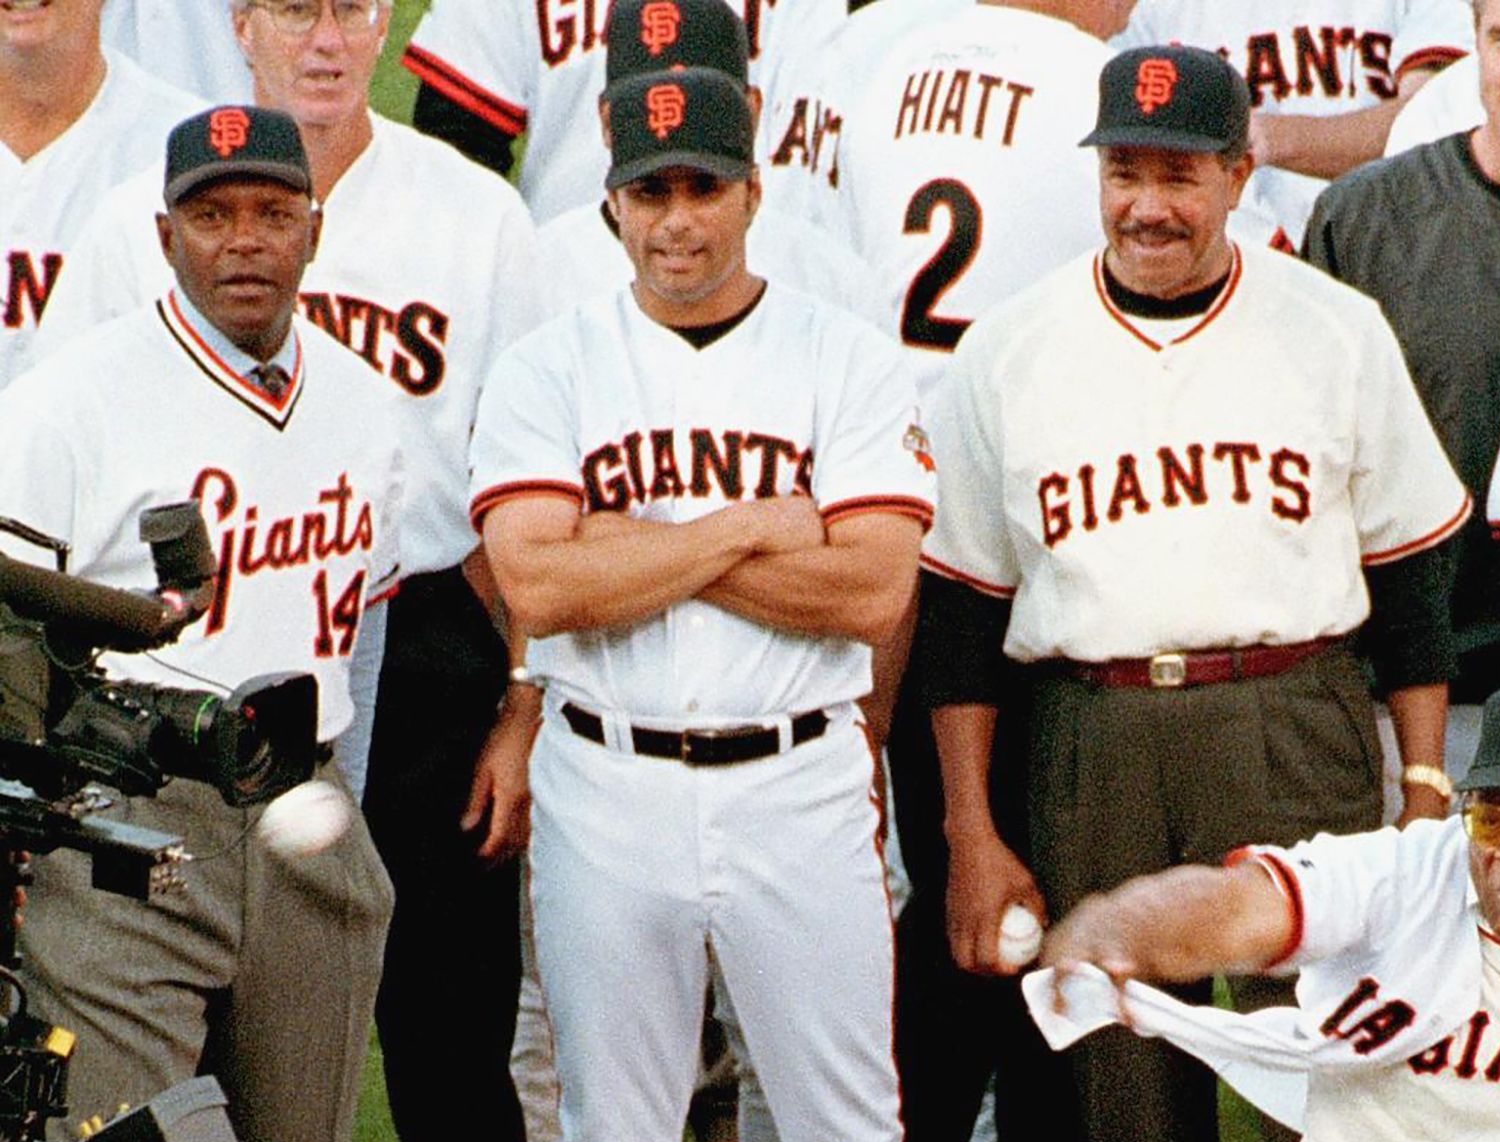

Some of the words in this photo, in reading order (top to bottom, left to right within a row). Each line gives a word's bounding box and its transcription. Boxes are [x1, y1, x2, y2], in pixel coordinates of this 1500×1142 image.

[894, 68, 1035, 147] HIATT
[1135, 57, 1179, 115] SF
[901, 176, 983, 354] 2
[1037, 441, 1311, 549] GIANTS
[189, 467, 373, 638] Giants
